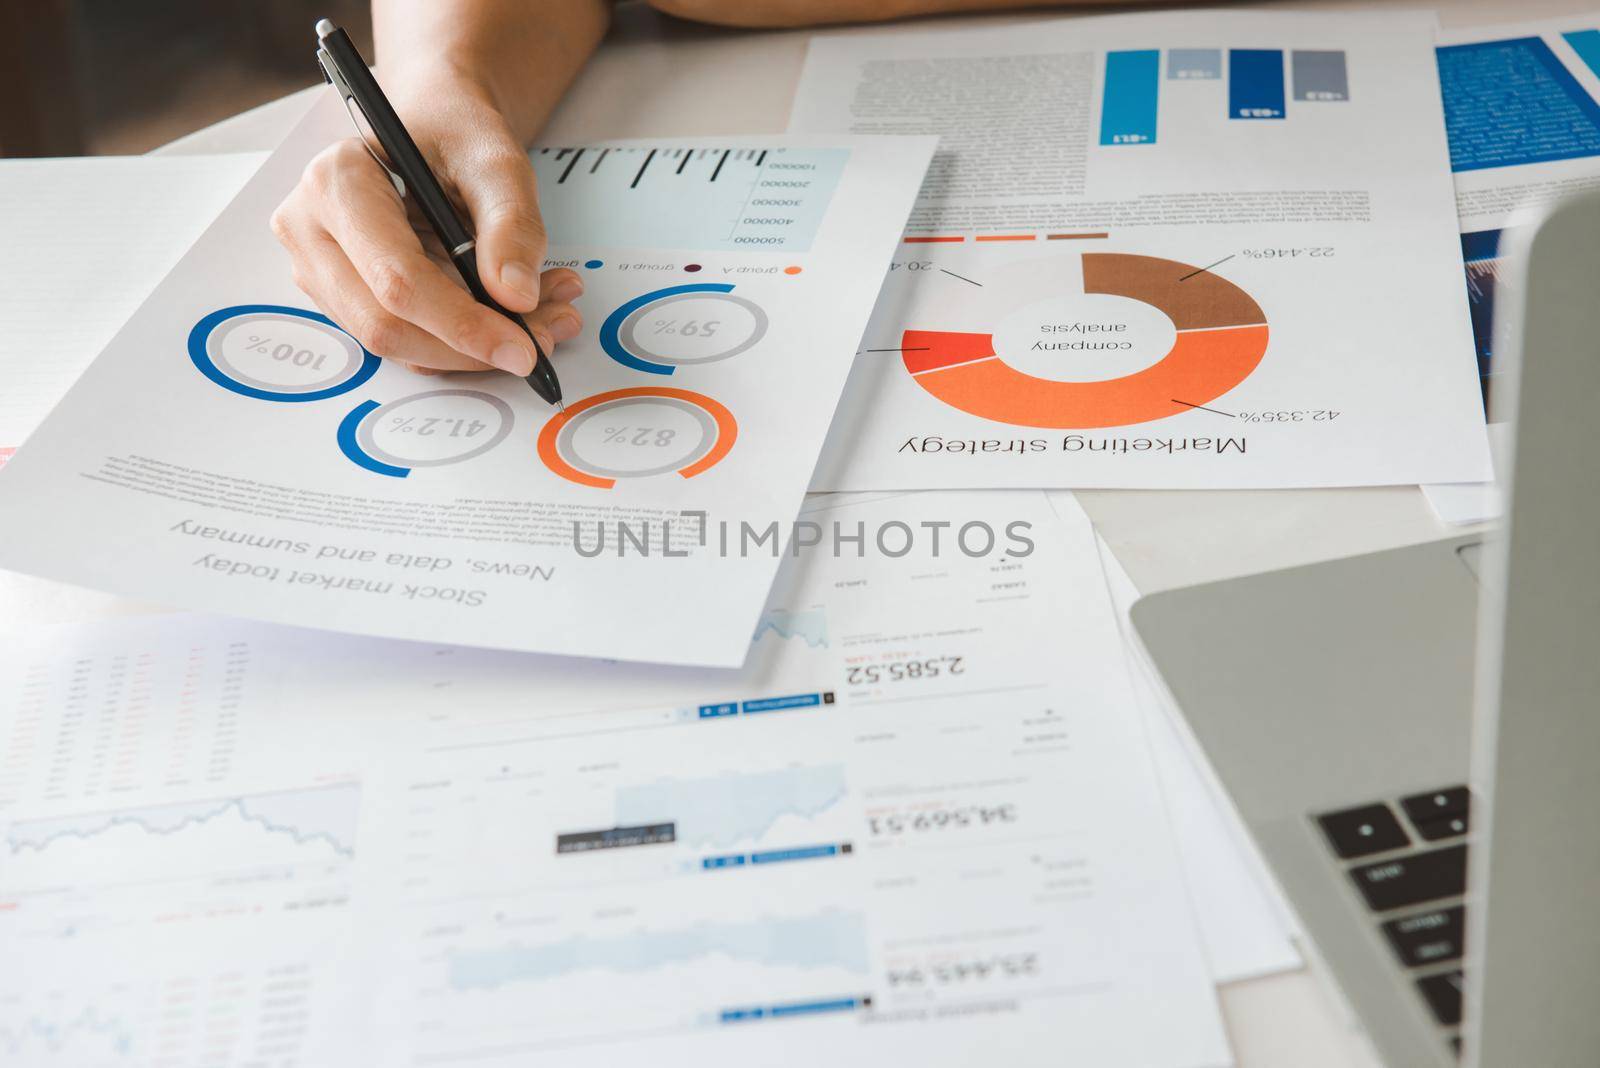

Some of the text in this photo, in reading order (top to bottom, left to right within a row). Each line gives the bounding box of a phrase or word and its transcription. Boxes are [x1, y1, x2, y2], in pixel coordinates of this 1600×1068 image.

[768, 162, 816, 171] 100000
[760, 180, 811, 189] 200000
[751, 198, 803, 207] 300000
[743, 217, 794, 225] 400000
[733, 236, 785, 245] 500000
[1242, 247, 1335, 258] 22.446%
[632, 263, 675, 272] group
[722, 266, 779, 275] group A
[653, 319, 721, 338] 59%
[1040, 323, 1127, 335] analysis
[1031, 340, 1132, 351] company
[247, 335, 328, 370] 100%
[1239, 410, 1341, 423] 42.335%
[390, 415, 486, 437] 41.2%
[603, 424, 676, 448] 82%
[898, 435, 1246, 455] Marketing strategy
[170, 518, 556, 582] News, data and summary
[193, 553, 488, 607] Stock market today
[847, 657, 965, 685] 2,585.52
